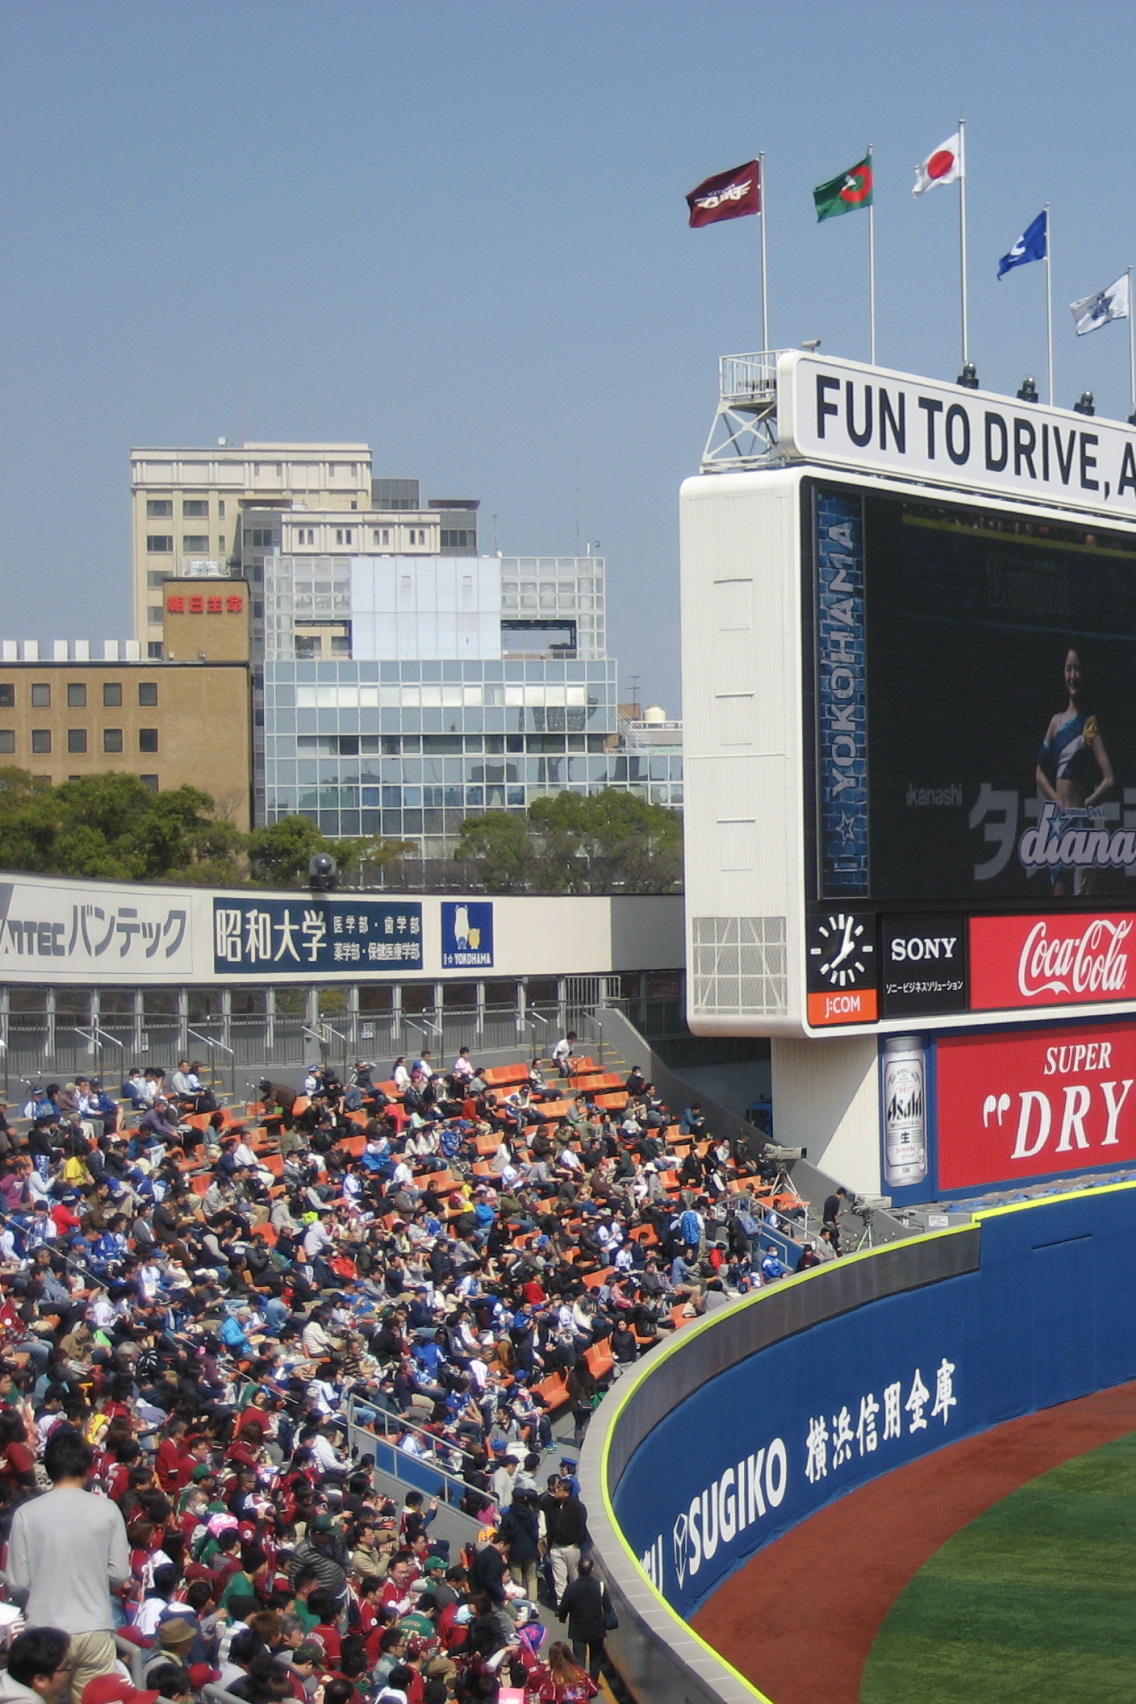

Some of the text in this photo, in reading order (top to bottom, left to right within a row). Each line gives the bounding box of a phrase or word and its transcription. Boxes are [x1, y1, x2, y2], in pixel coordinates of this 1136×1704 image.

[815, 373, 906, 454] FUN
[917, 395, 972, 466] TO
[983, 410, 1111, 501] DRIVE,
[827, 519, 859, 799] YOKOHAMA
[68, 904, 187, 959] バンテック
[215, 908, 328, 963] 昭和大学
[891, 937, 957, 961] SONY
[454, 952, 492, 966] YOKOHAMA
[1018, 919, 1134, 997] Coca-Cola
[824, 995, 861, 1019] J:COM
[885, 979, 964, 995] ソニービジネスソリューション
[1043, 1041, 1113, 1077] SUPER
[887, 1090, 923, 1122] Asahi
[900, 1131, 911, 1144] 生
[804, 1357, 958, 1485] 横浜信用金庫
[688, 1437, 788, 1576] SUGIKO
